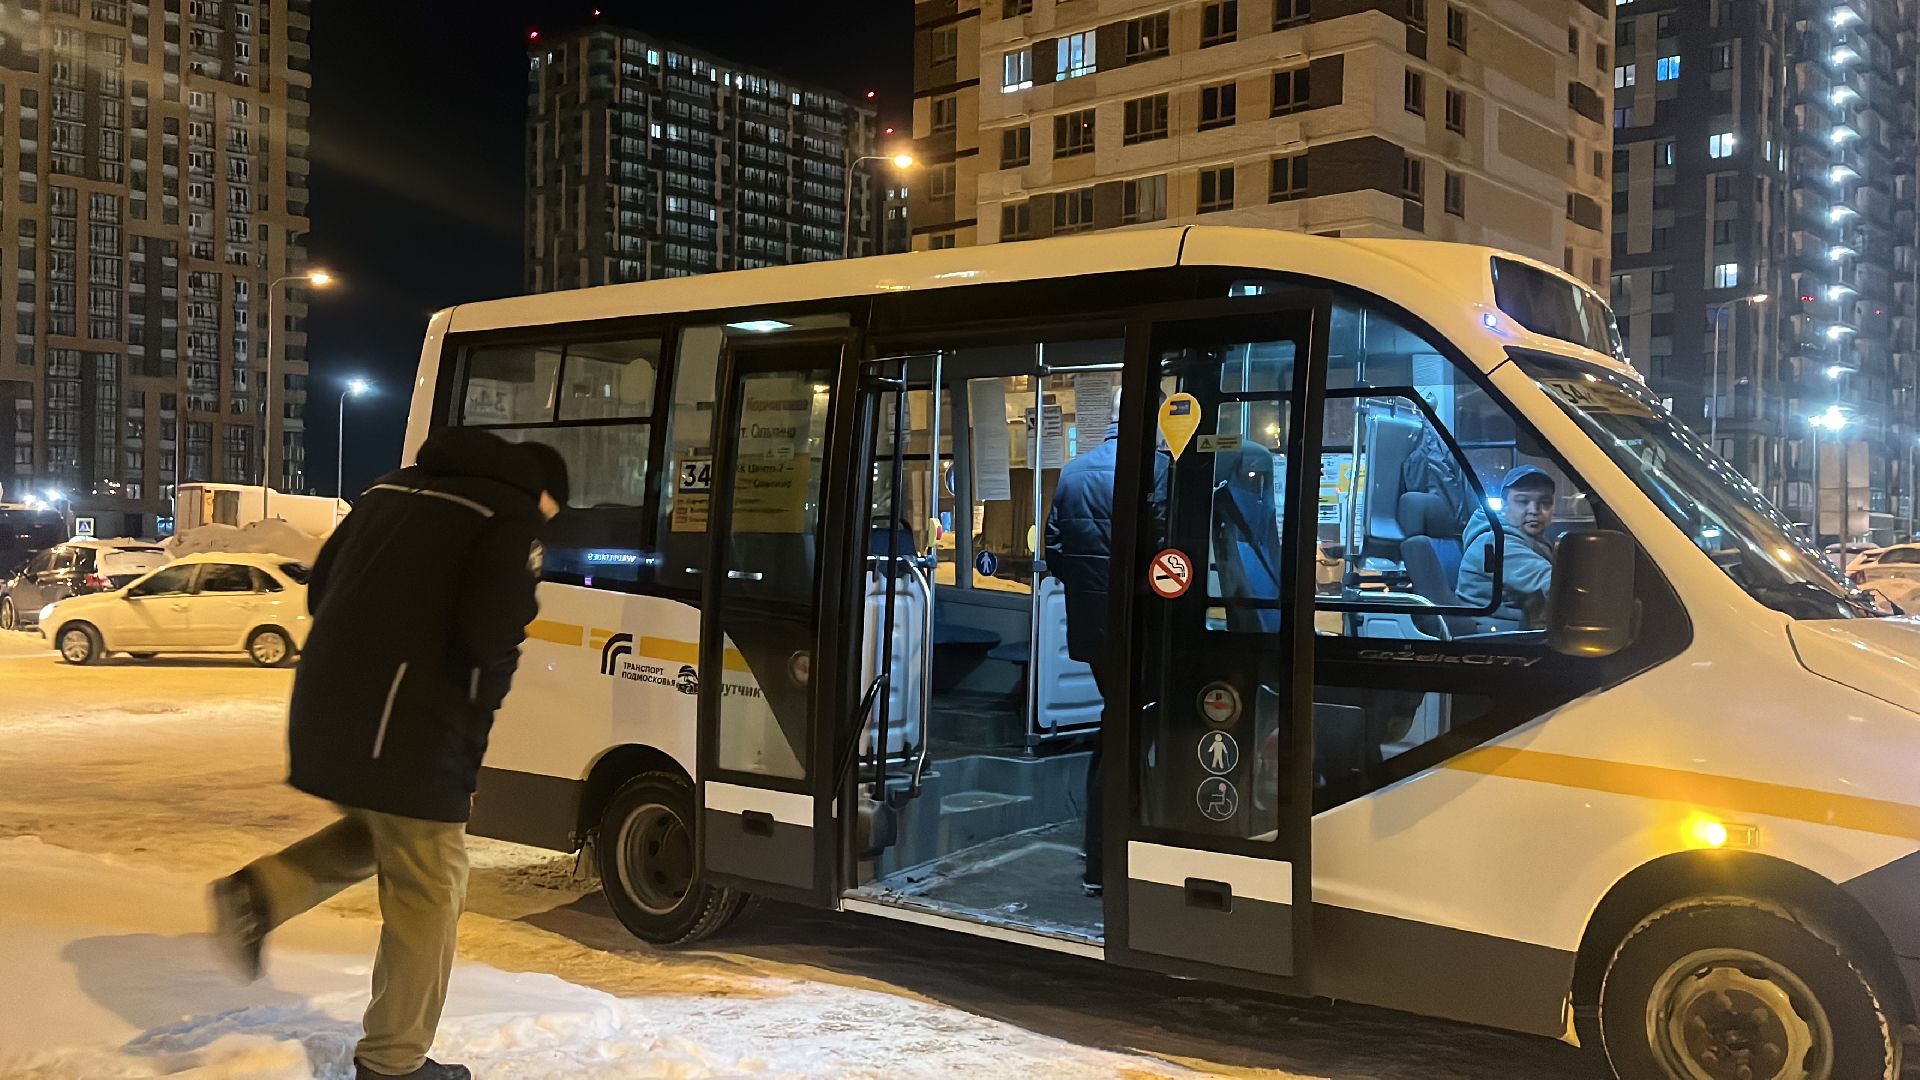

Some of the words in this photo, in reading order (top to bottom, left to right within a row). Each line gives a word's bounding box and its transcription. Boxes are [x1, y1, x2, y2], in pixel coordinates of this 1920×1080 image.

[684, 464, 711, 486] 34
[623, 662, 664, 676] ТРАНСПОРТ
[621, 671, 677, 687] ПОДМОСКОВЬЯ
